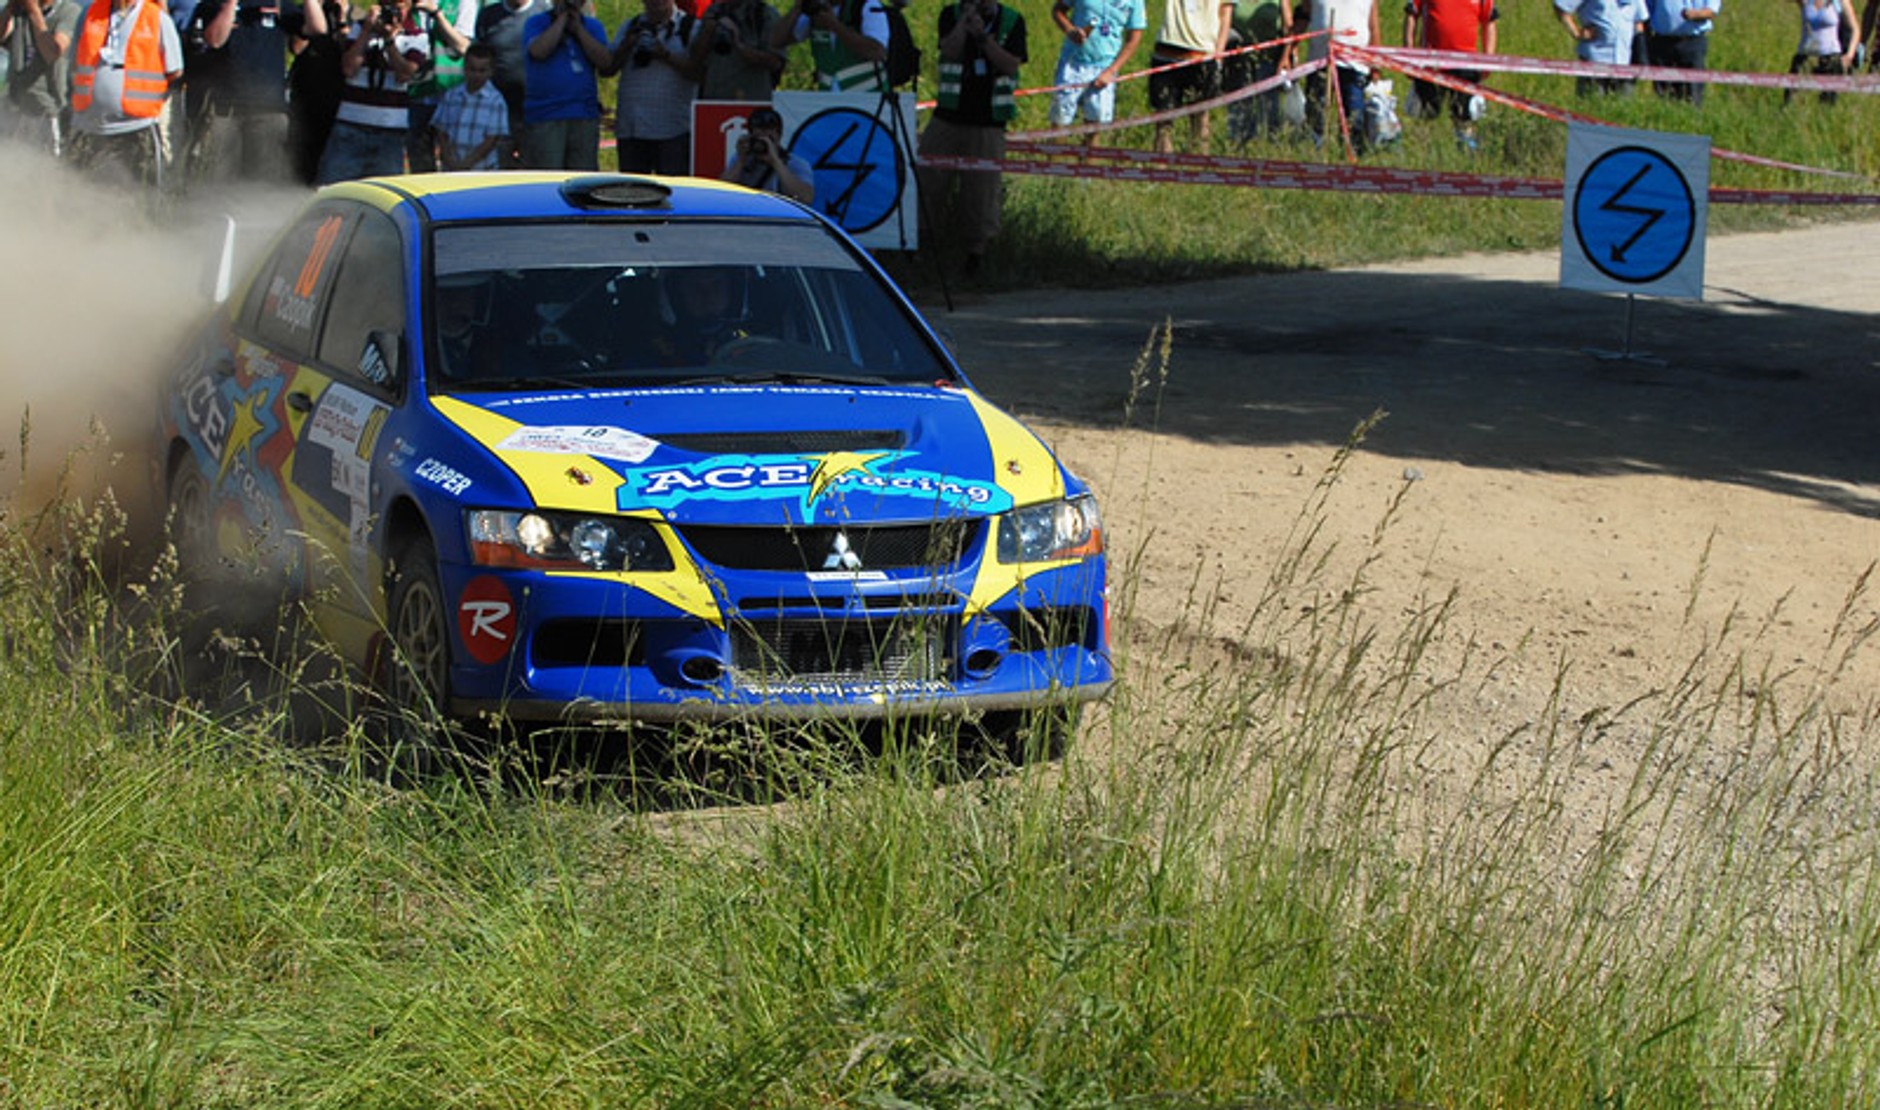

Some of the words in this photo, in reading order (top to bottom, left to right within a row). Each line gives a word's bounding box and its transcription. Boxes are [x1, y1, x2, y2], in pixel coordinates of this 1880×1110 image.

[294, 215, 342, 299] 10
[582, 427, 608, 438] 10
[646, 464, 807, 494] ACE
[834, 473, 989, 502] racing
[461, 601, 510, 640] R
